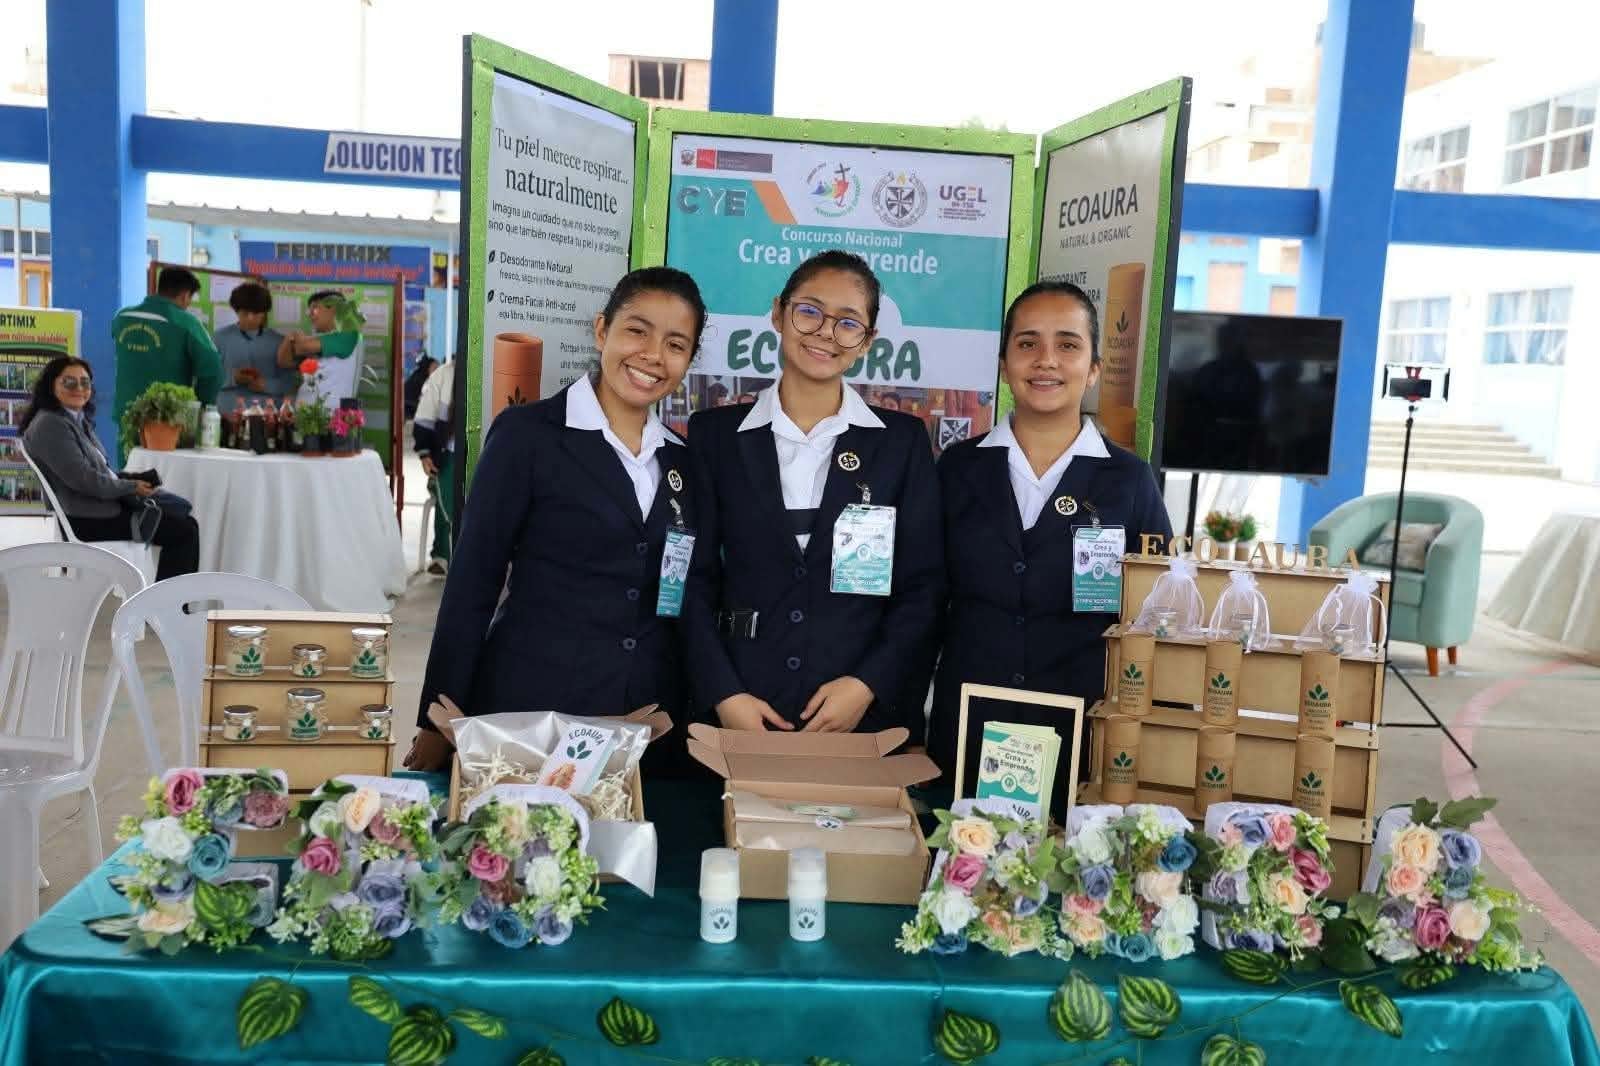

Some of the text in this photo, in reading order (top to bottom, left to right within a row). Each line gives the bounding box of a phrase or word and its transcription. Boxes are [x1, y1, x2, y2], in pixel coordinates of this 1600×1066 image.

[496, 128, 512, 151] Tu
[516, 136, 540, 159] piel
[543, 147, 581, 171] merece
[505, 168, 618, 215] naturalmente
[678, 185, 748, 217] CYE
[522, 209, 532, 220] un
[1059, 184, 1139, 229] ECOAURA
[489, 220, 504, 232] sino
[1060, 225, 1133, 249] NATURAL & ORGANIC
[781, 227, 903, 248] Concurso Nacional
[739, 239, 792, 265] Crea
[547, 261, 573, 274] Natural
[499, 292, 524, 306] Crema
[567, 727, 606, 746] ECOAURA
